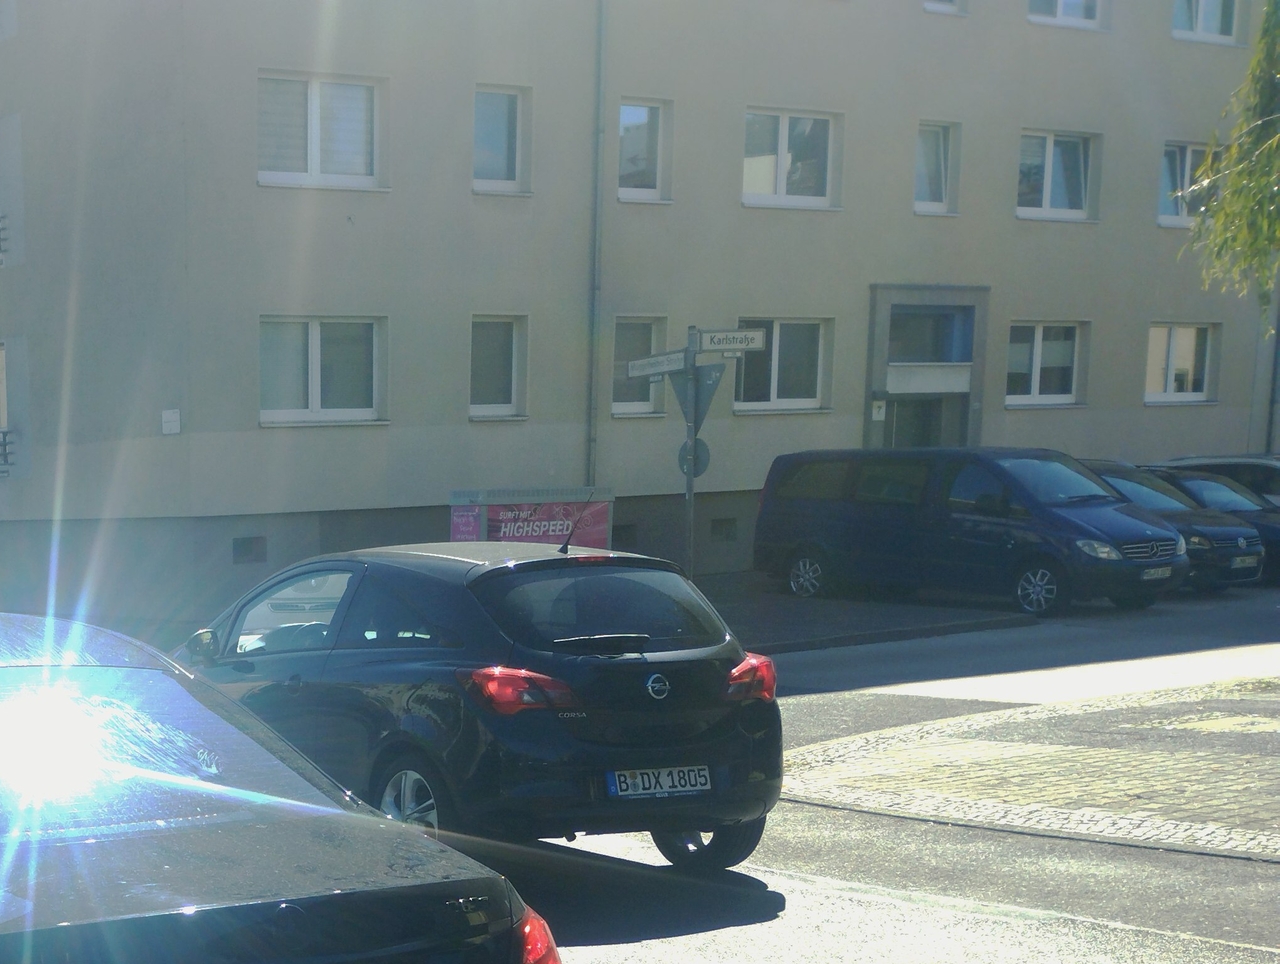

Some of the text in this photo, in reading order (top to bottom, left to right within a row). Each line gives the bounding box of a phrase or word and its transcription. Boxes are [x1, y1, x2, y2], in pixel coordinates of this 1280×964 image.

[709, 334, 755, 347] Karlstraße
[499, 510, 531, 520] SURFT MIT
[500, 520, 573, 538] HIGHSPEED
[618, 773, 629, 792] B
[640, 771, 663, 791] DX
[667, 768, 708, 789] 1805
